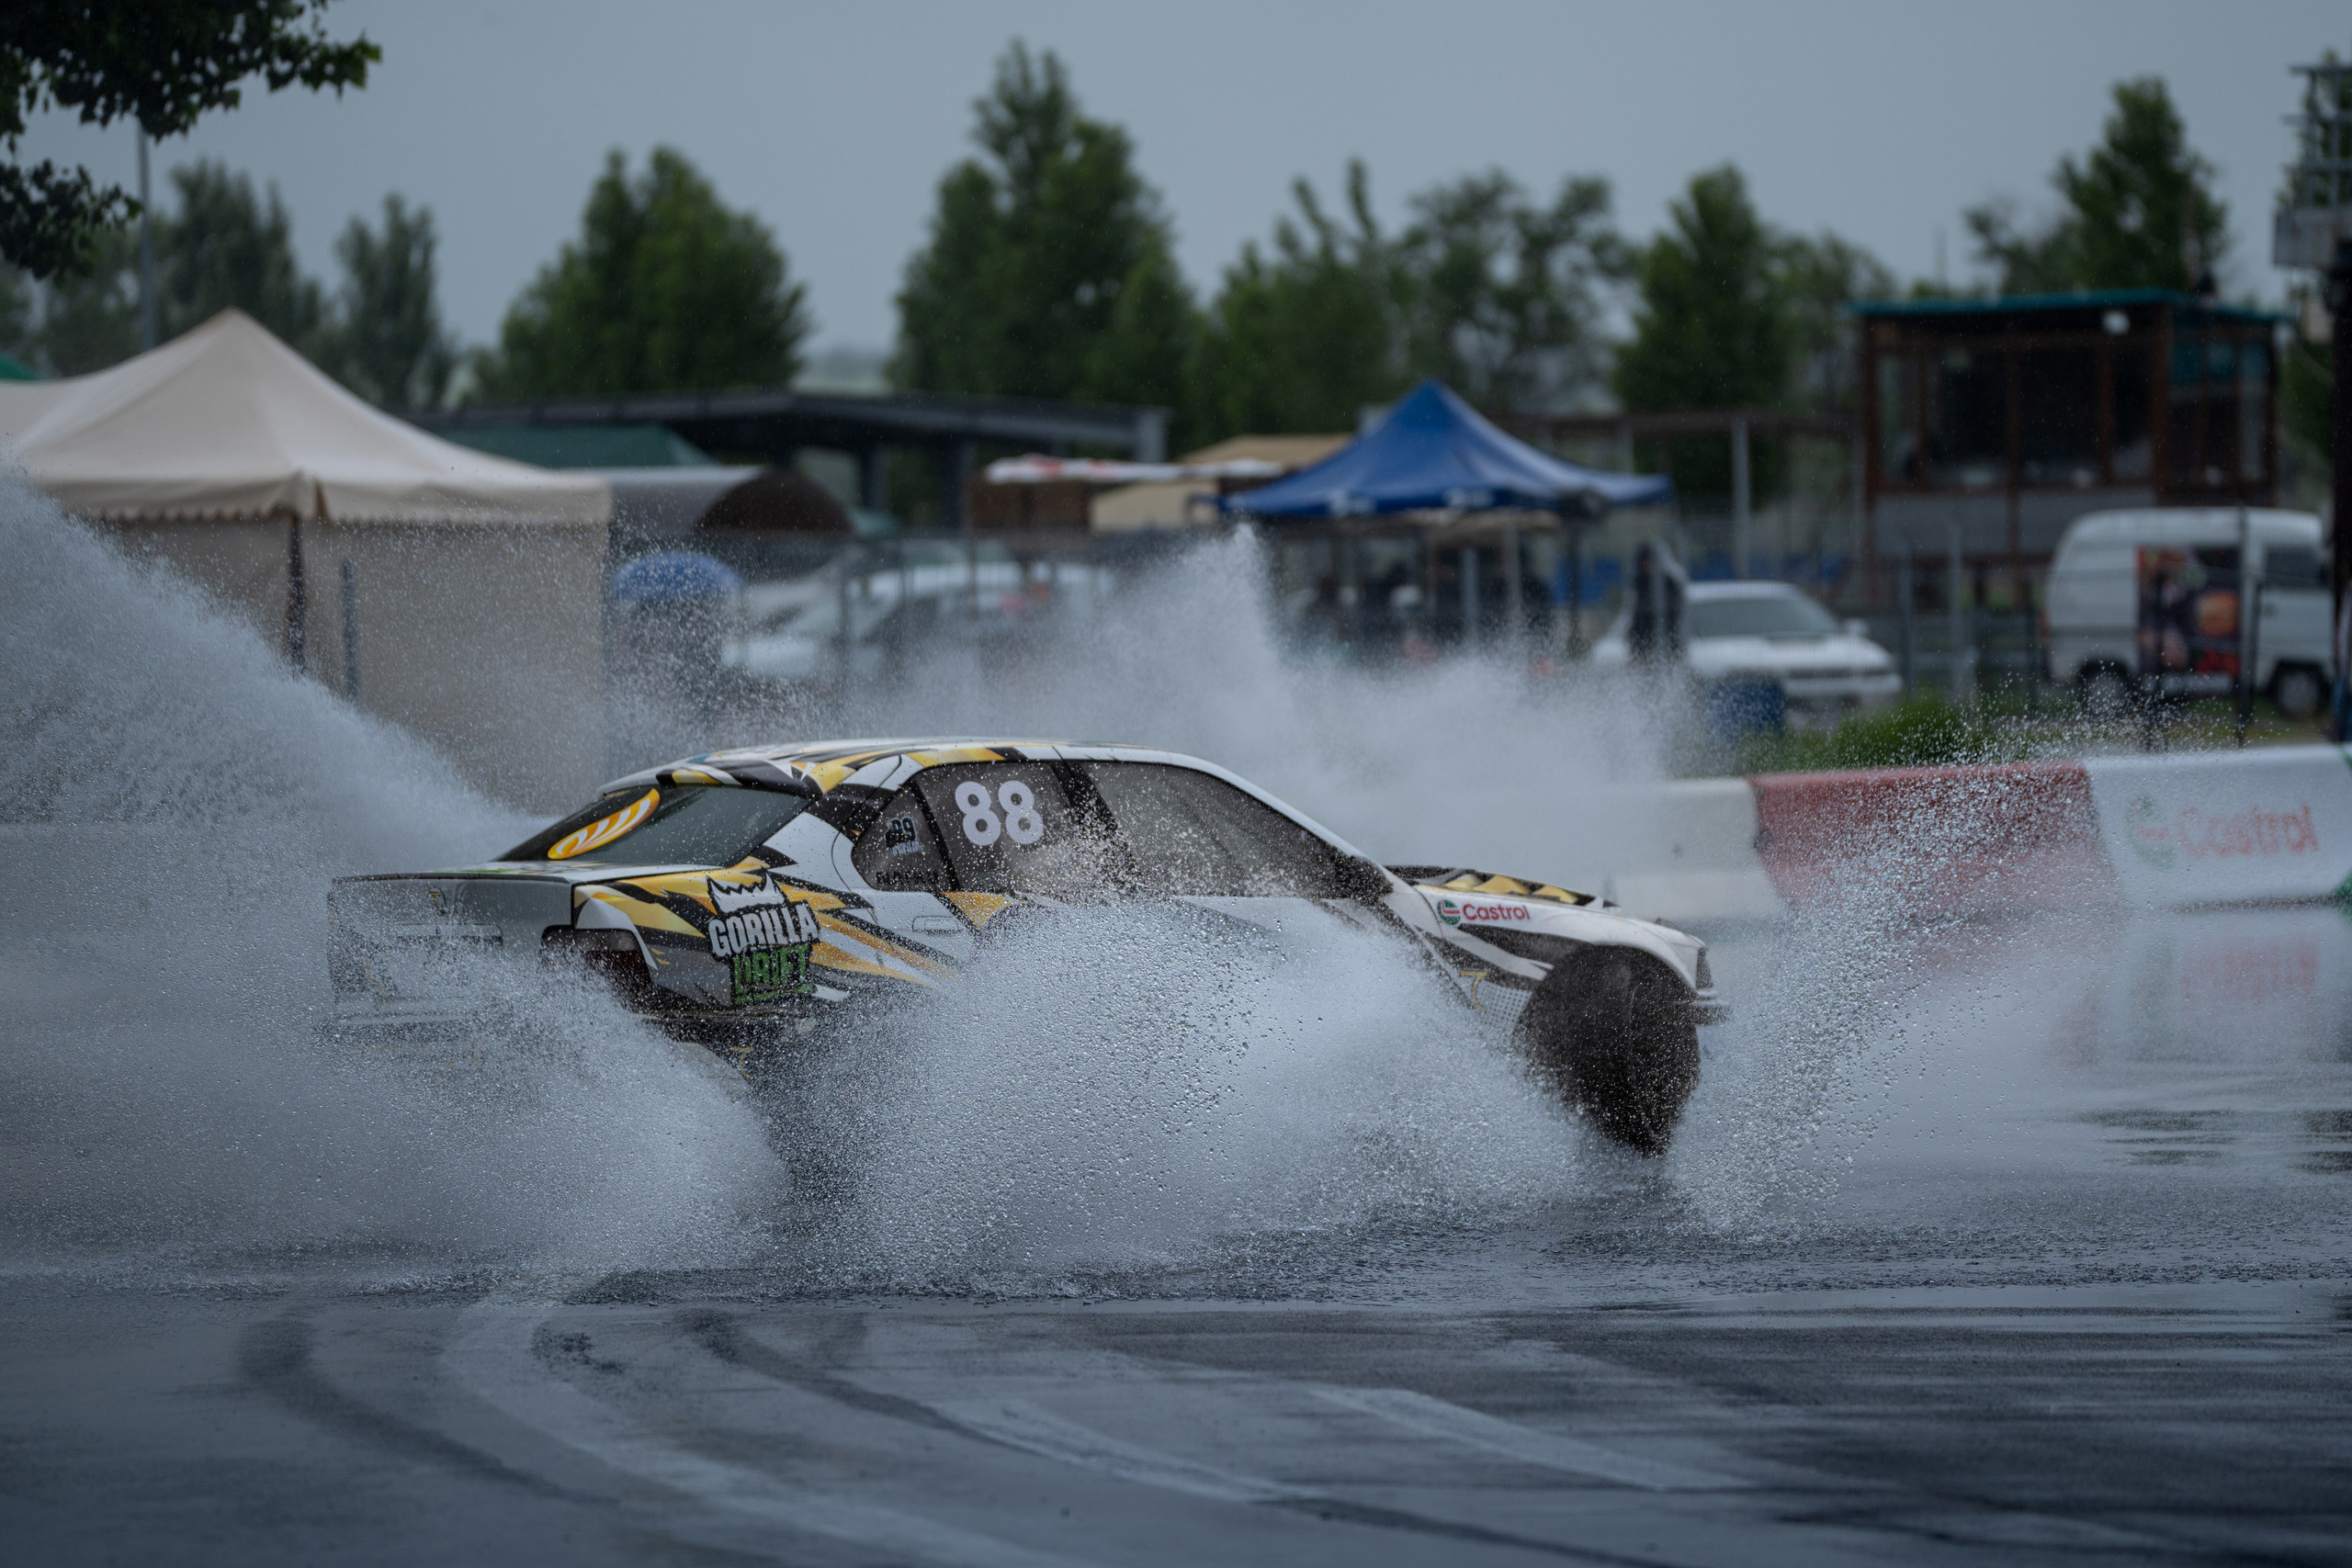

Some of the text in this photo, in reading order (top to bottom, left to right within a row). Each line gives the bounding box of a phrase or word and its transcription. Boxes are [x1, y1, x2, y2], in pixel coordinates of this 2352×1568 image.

[955, 780, 1045, 846] 88
[2177, 801, 2320, 860] Castrol
[708, 903, 820, 958] GORILLA
[1463, 903, 1532, 921] Castrol
[734, 943, 810, 995] DRIFT
